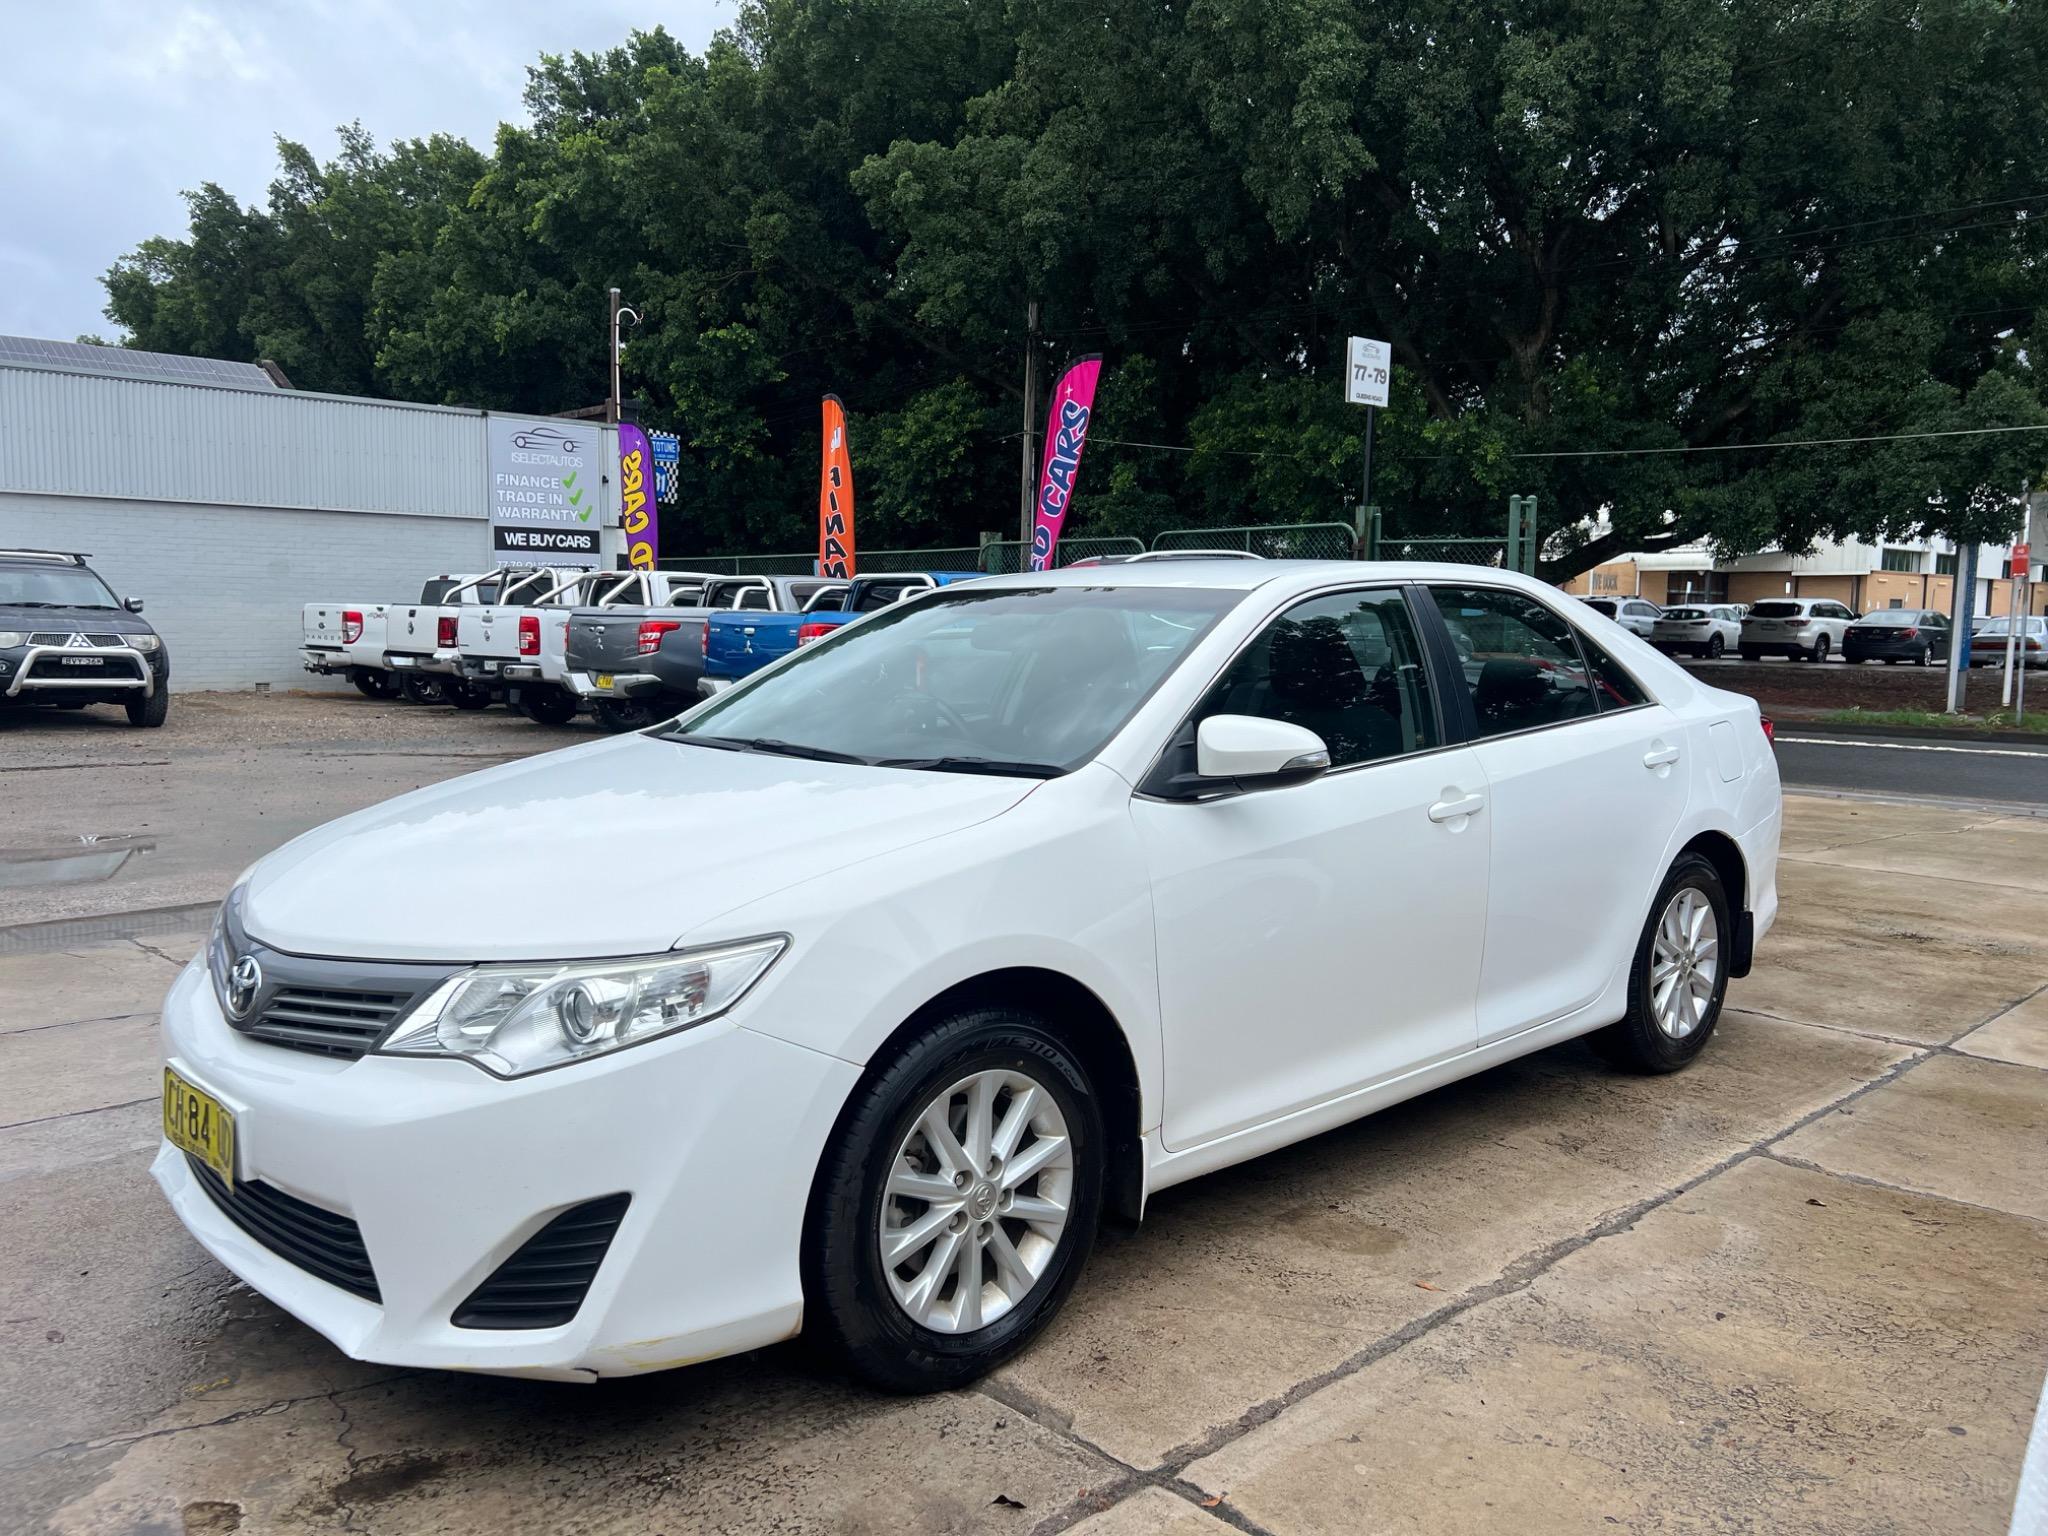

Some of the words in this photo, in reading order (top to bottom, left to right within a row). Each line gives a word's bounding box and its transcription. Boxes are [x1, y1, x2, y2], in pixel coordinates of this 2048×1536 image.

[1354, 363, 1387, 385] 77-79
[1041, 399, 1090, 518] CARS
[496, 473, 560, 489] FINANCE
[497, 489, 546, 504] TRADE
[549, 493, 563, 505] IN
[497, 506, 579, 522] WARRANTY
[504, 532, 528, 546] WE
[529, 533, 556, 547] BUY
[556, 534, 591, 549] CARS
